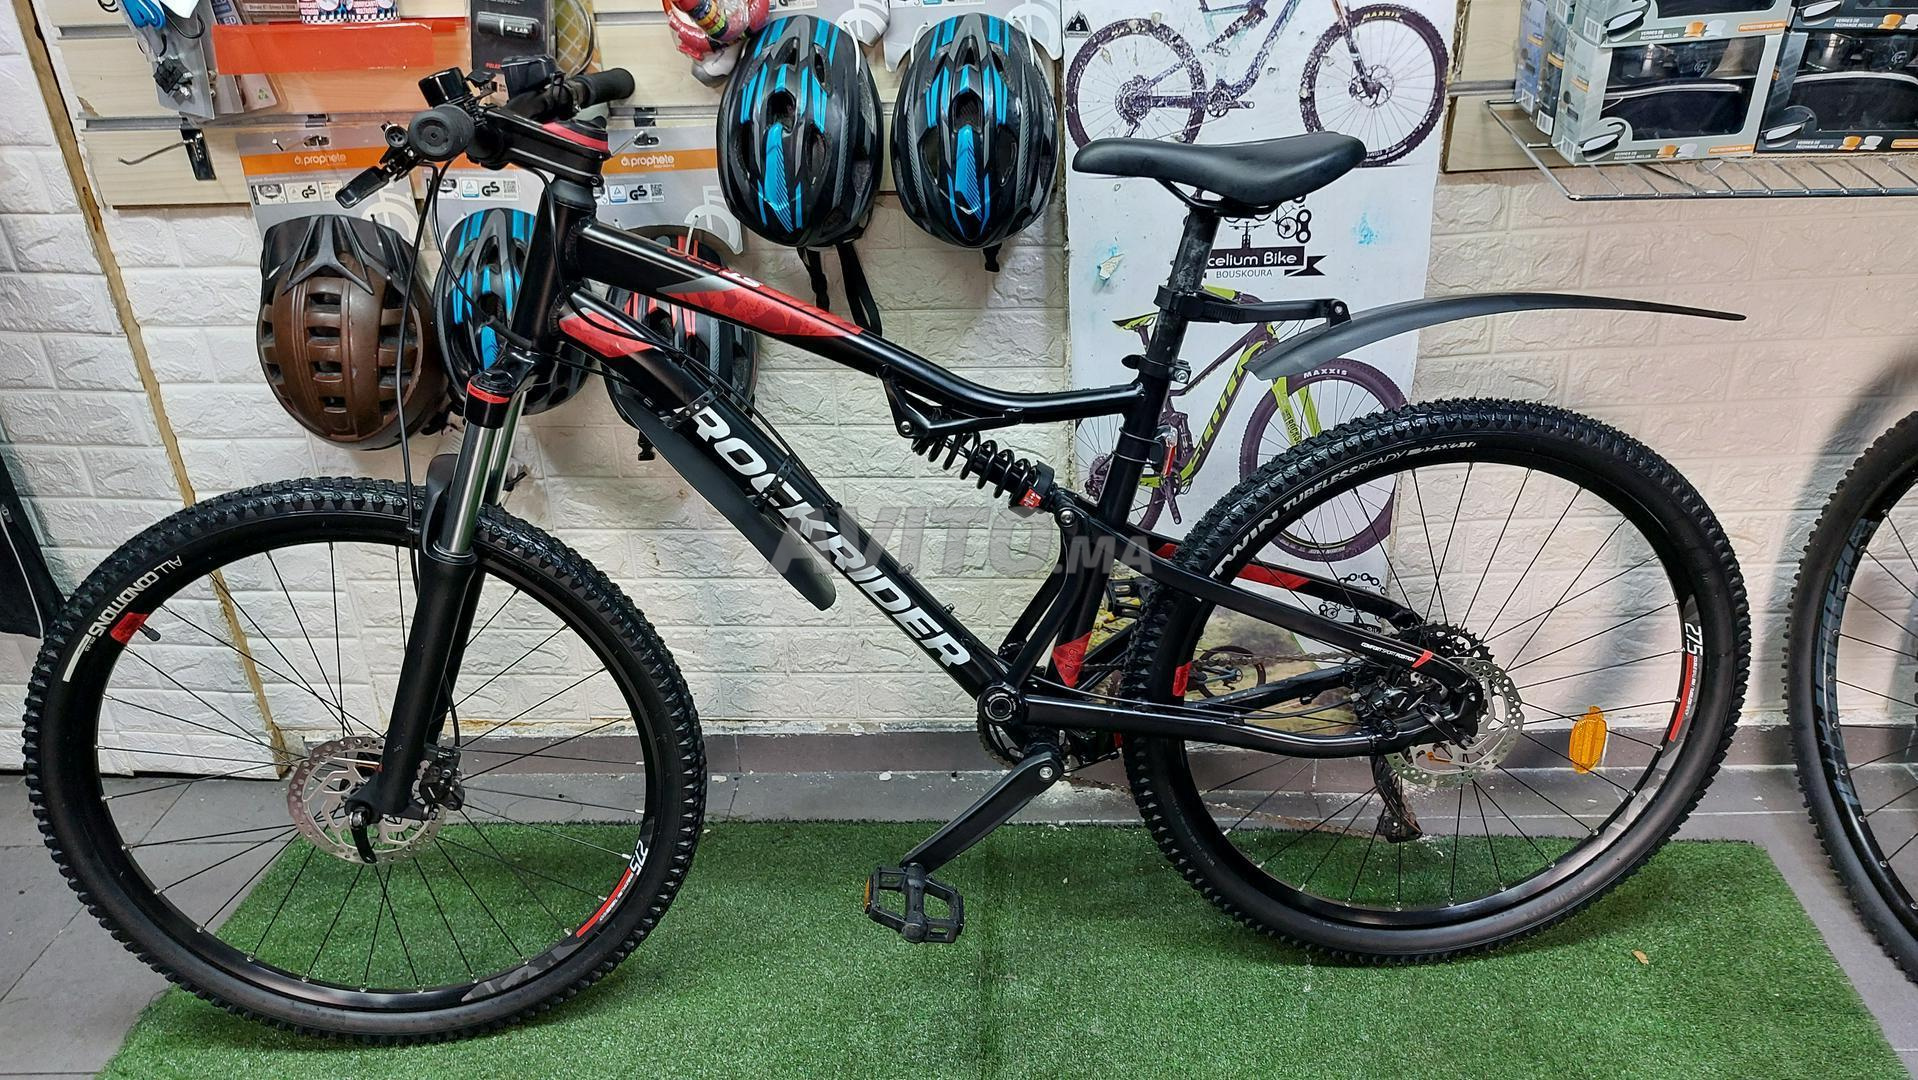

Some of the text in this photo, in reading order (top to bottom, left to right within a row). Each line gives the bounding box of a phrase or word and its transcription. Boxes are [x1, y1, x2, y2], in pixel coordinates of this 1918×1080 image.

[302, 185, 317, 199] GS
[482, 181, 500, 197] GS
[630, 185, 648, 200] GS
[1208, 251, 1297, 267] celium Bike
[1216, 269, 1273, 279] BOUSKOURA
[1303, 368, 1348, 379] MAXXIS
[673, 406, 971, 667] ROCKRIDER
[88, 555, 183, 637] ALL CONDITIONS
